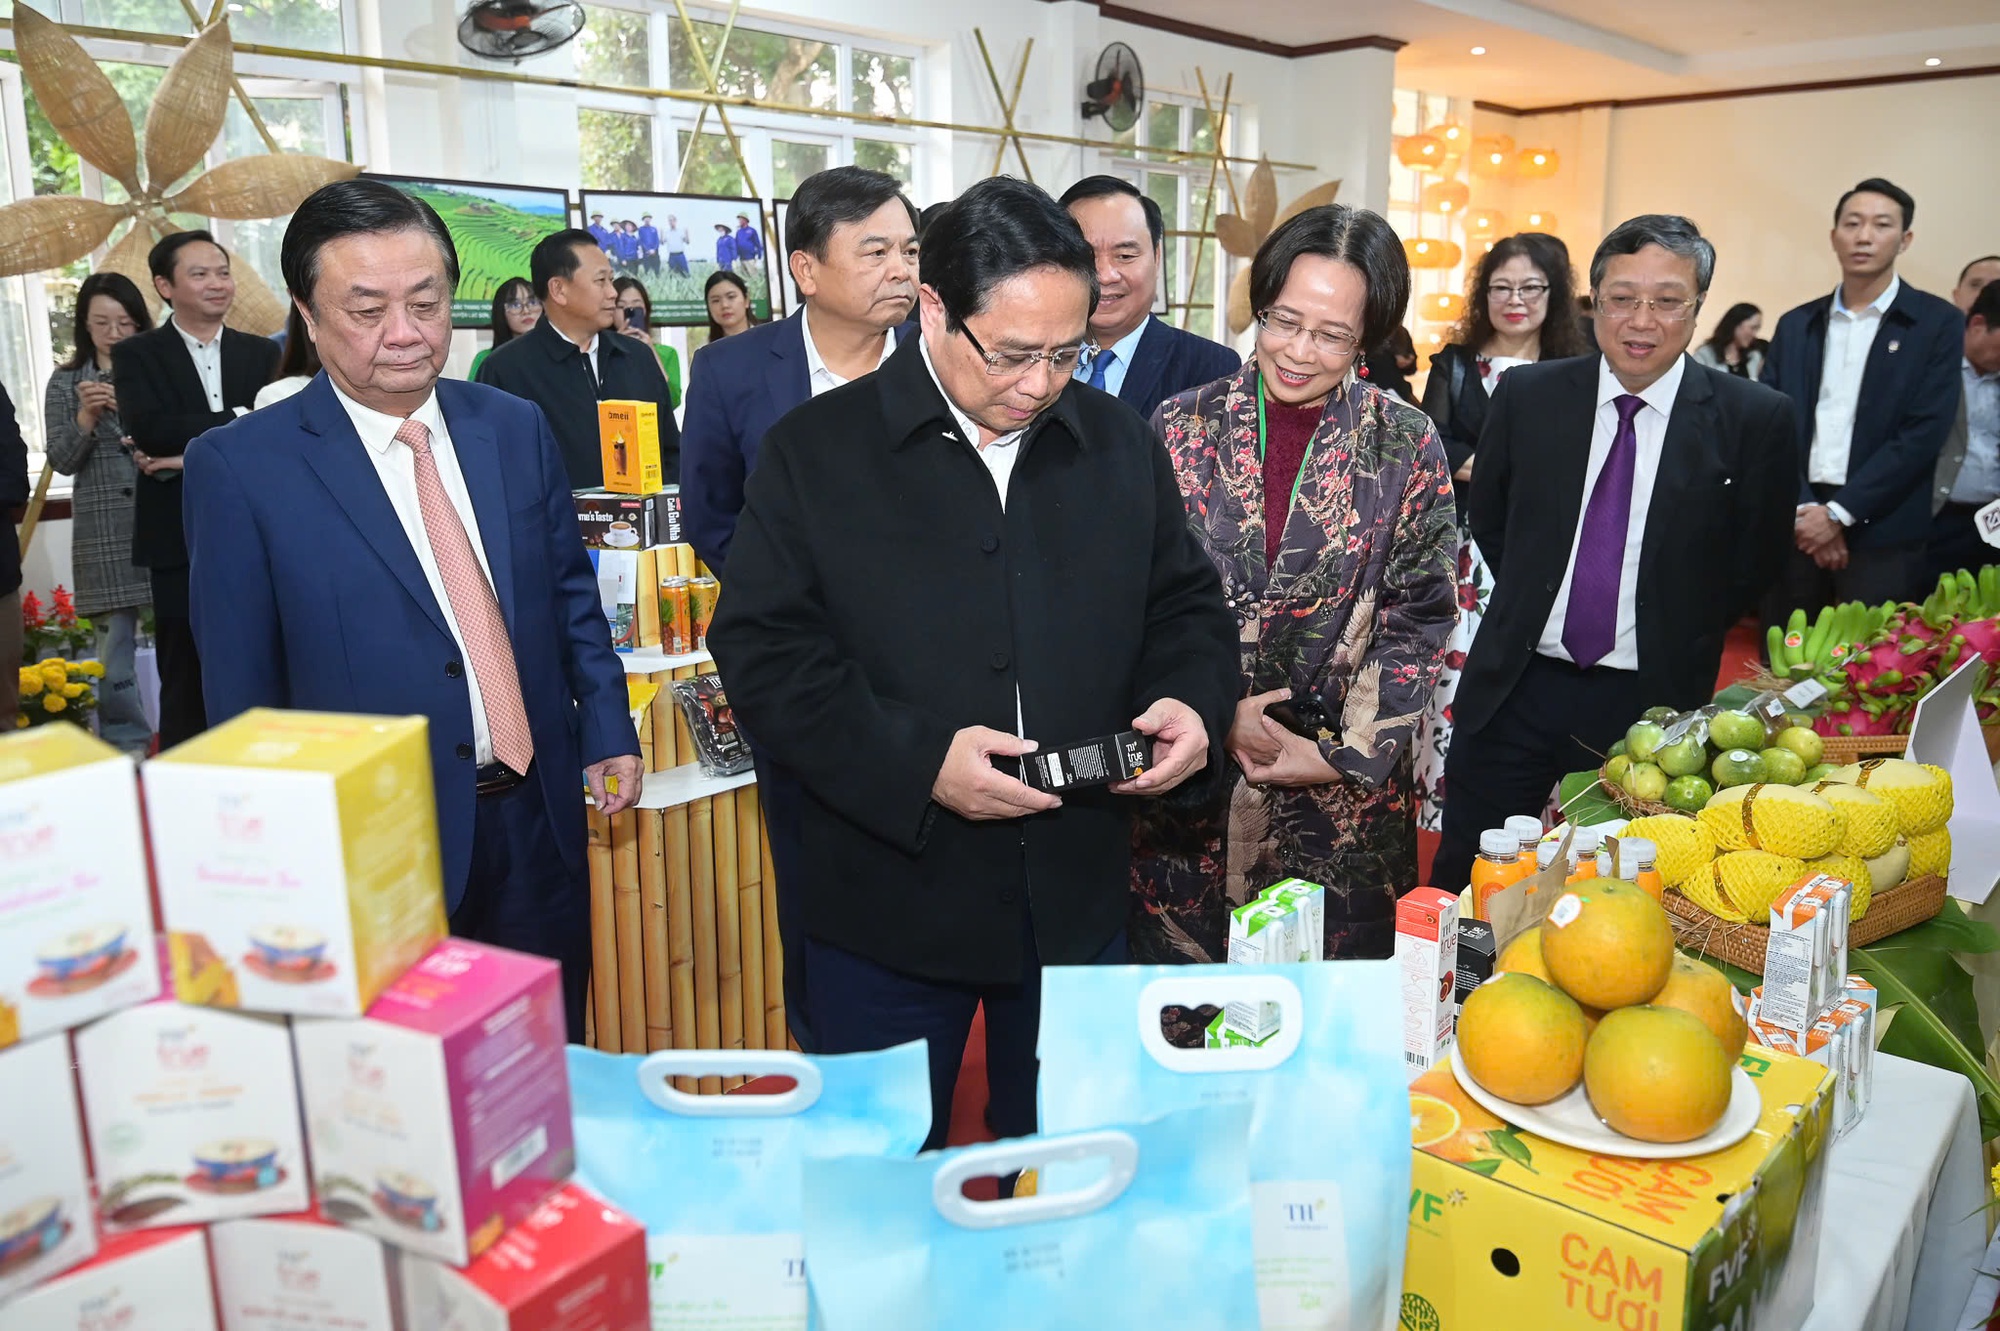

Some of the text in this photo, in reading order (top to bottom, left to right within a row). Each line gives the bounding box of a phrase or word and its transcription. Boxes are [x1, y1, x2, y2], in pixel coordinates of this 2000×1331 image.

[594, 510, 614, 522] Taste
[1127, 751, 1144, 763] true
[1441, 933, 1457, 954] true
[1621, 1161, 1713, 1225] CAM
[1561, 1232, 1663, 1303] CAM
[1558, 1271, 1660, 1331] TƯƠI
